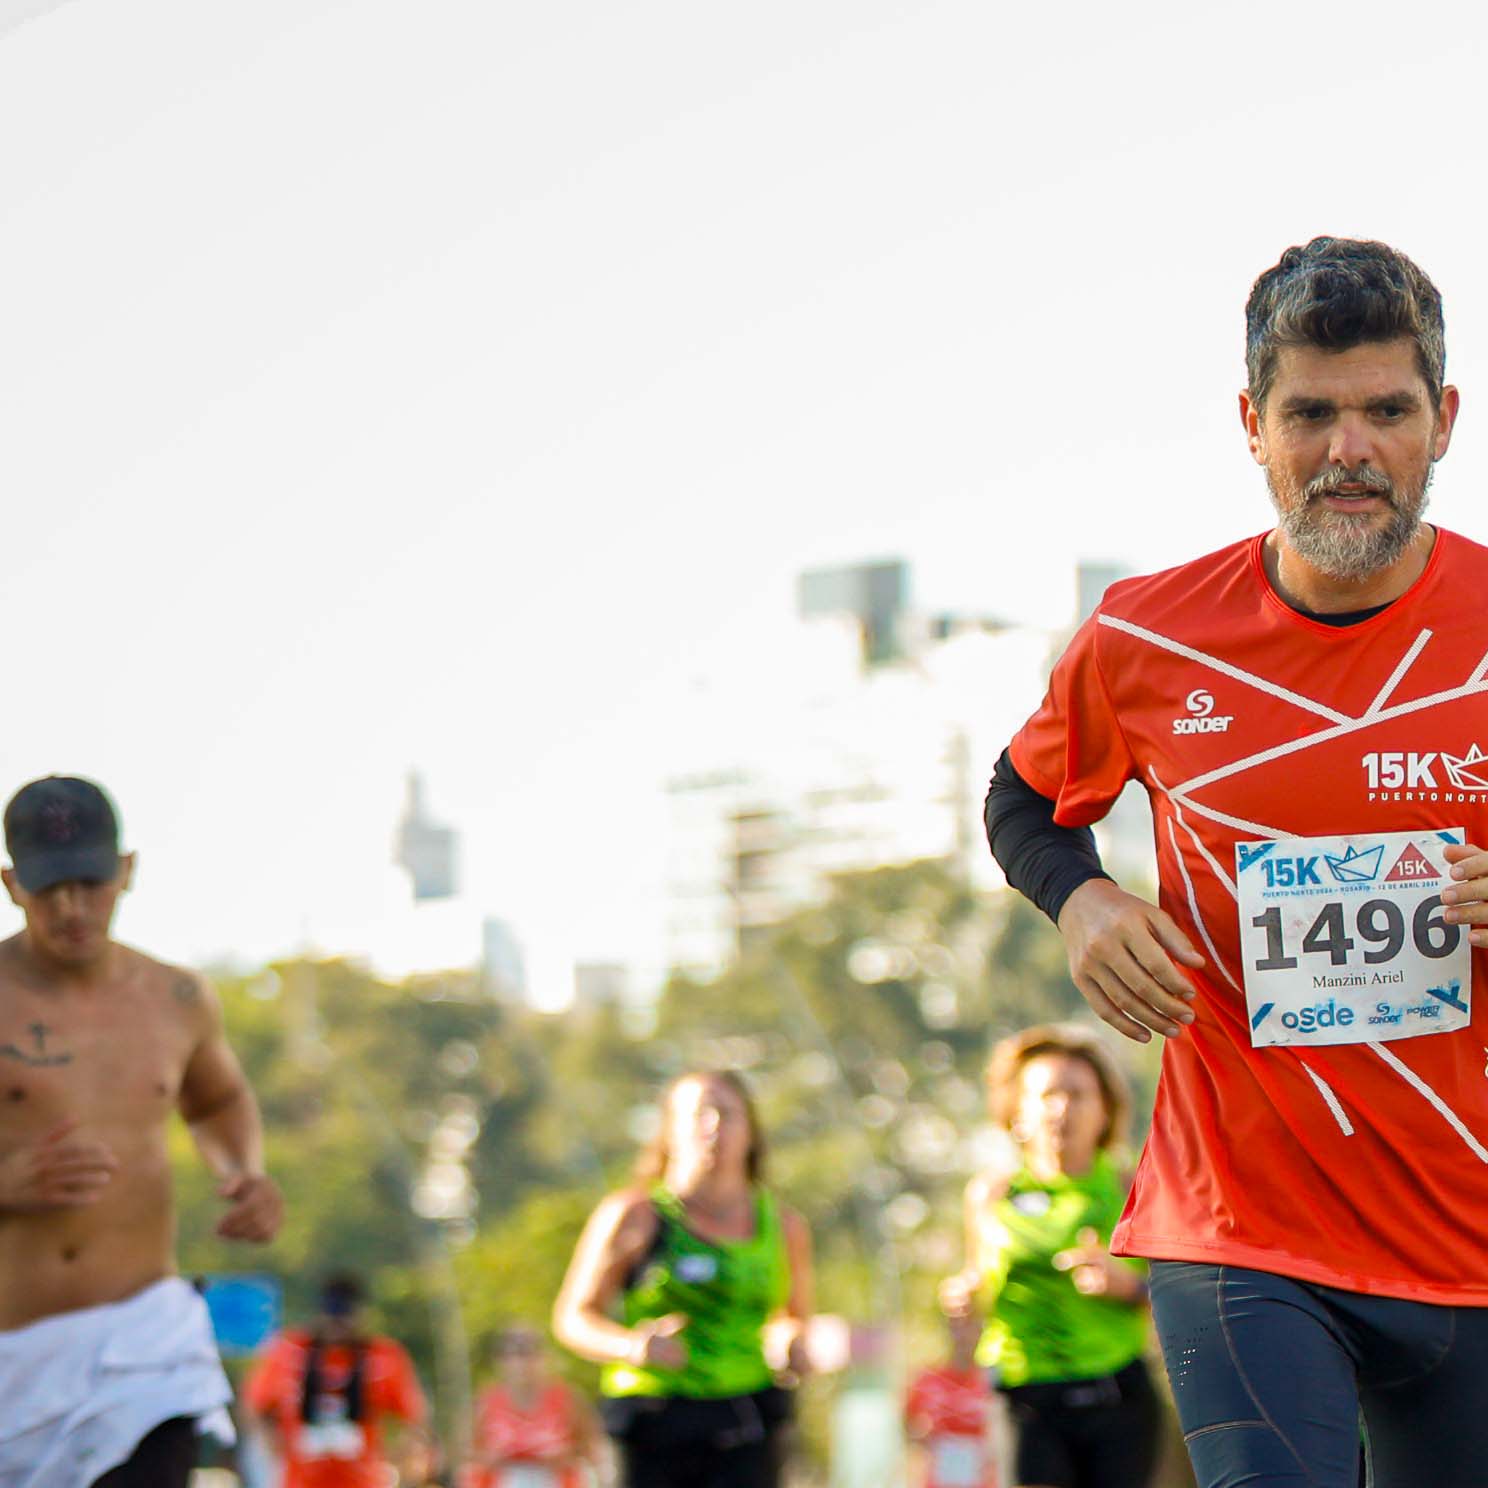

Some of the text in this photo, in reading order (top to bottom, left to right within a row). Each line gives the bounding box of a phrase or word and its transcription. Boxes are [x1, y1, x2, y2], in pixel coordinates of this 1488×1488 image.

[1361, 752, 1438, 789] 15K
[1368, 792, 1438, 802] PUERTO
[1260, 856, 1322, 888] 15K
[1396, 859, 1429, 876] 15K
[1400, 881, 1420, 889] ABRIL
[1252, 894, 1461, 972] 1496
[1312, 970, 1404, 988] Manzini Ariel
[1281, 999, 1355, 1032] osde
